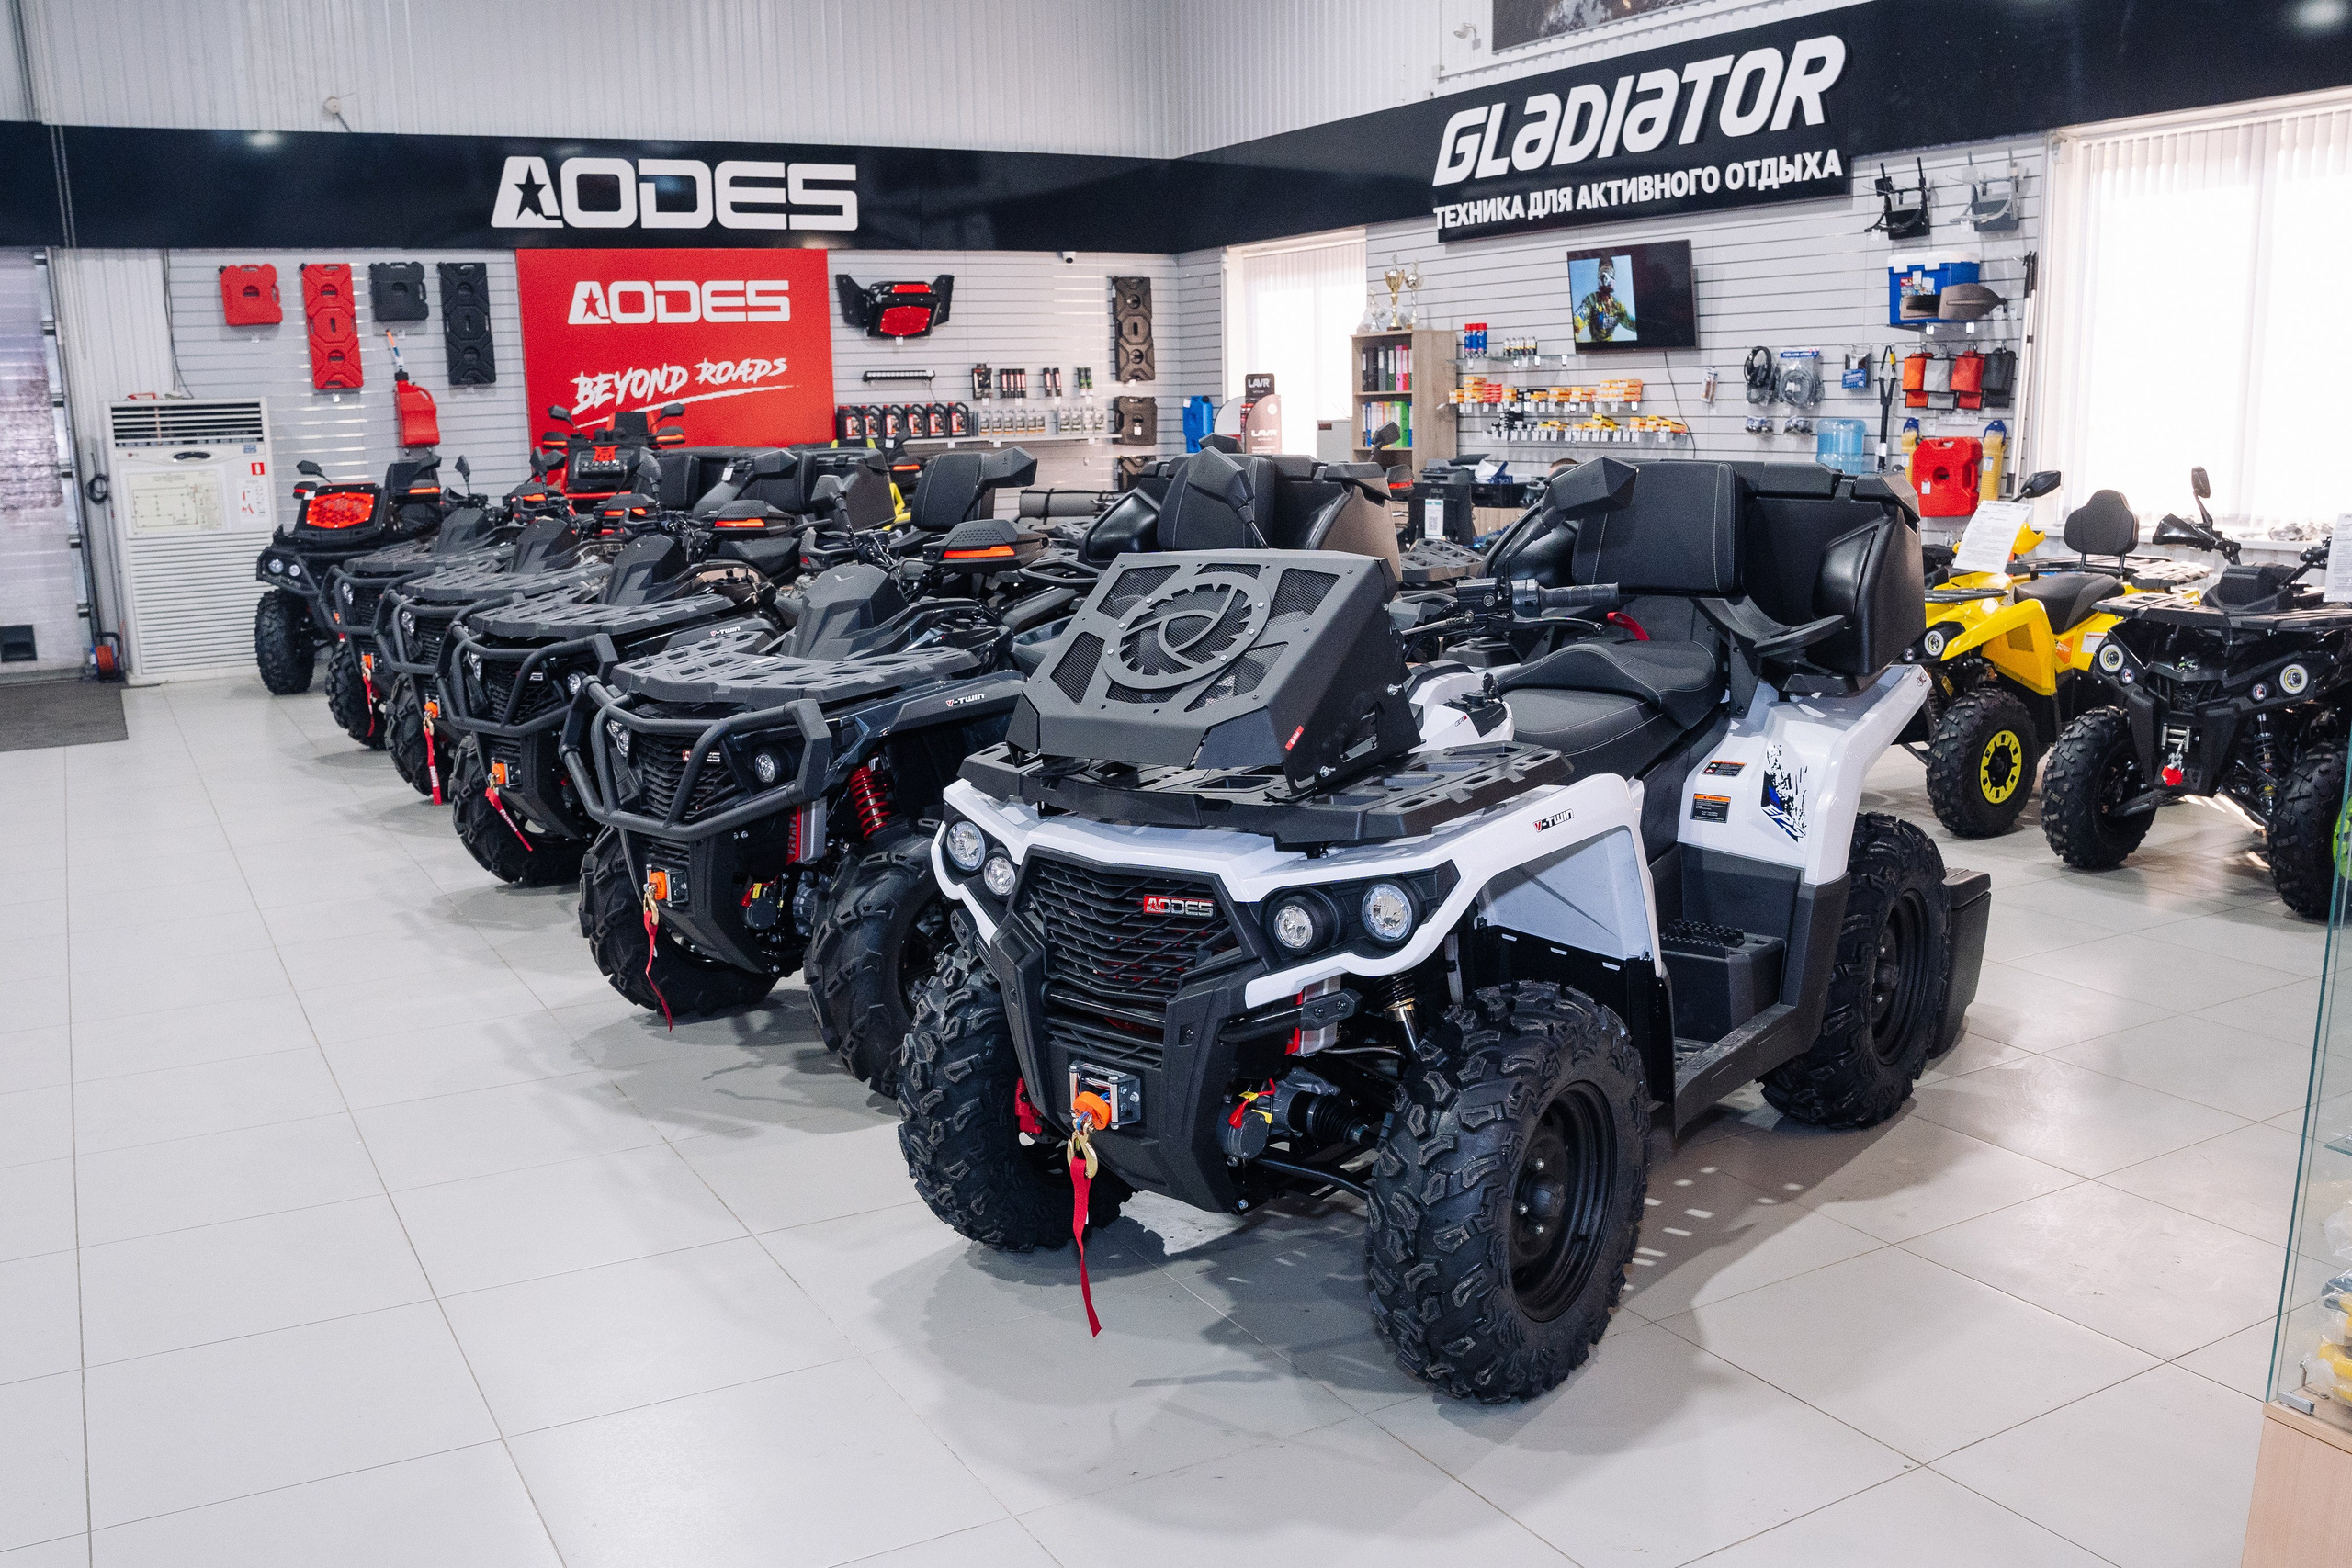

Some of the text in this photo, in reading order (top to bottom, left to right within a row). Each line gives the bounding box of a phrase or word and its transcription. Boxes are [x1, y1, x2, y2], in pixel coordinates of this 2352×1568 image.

[1432, 34, 1847, 187] GLADIATOR
[491, 155, 859, 231] AODES
[1433, 148, 1843, 230] ТЕХНИКА ДЛЯ АКТИВНОГО ОТДЫХА
[567, 279, 791, 325] AODES
[571, 357, 788, 416] BEYOND ROADS
[1248, 378, 1270, 388] LAVR
[945, 693, 985, 707] V-TWIN
[1533, 808, 1575, 833] V-TWIN
[1761, 804, 1806, 839] EPS
[1146, 897, 1214, 917] AODES
